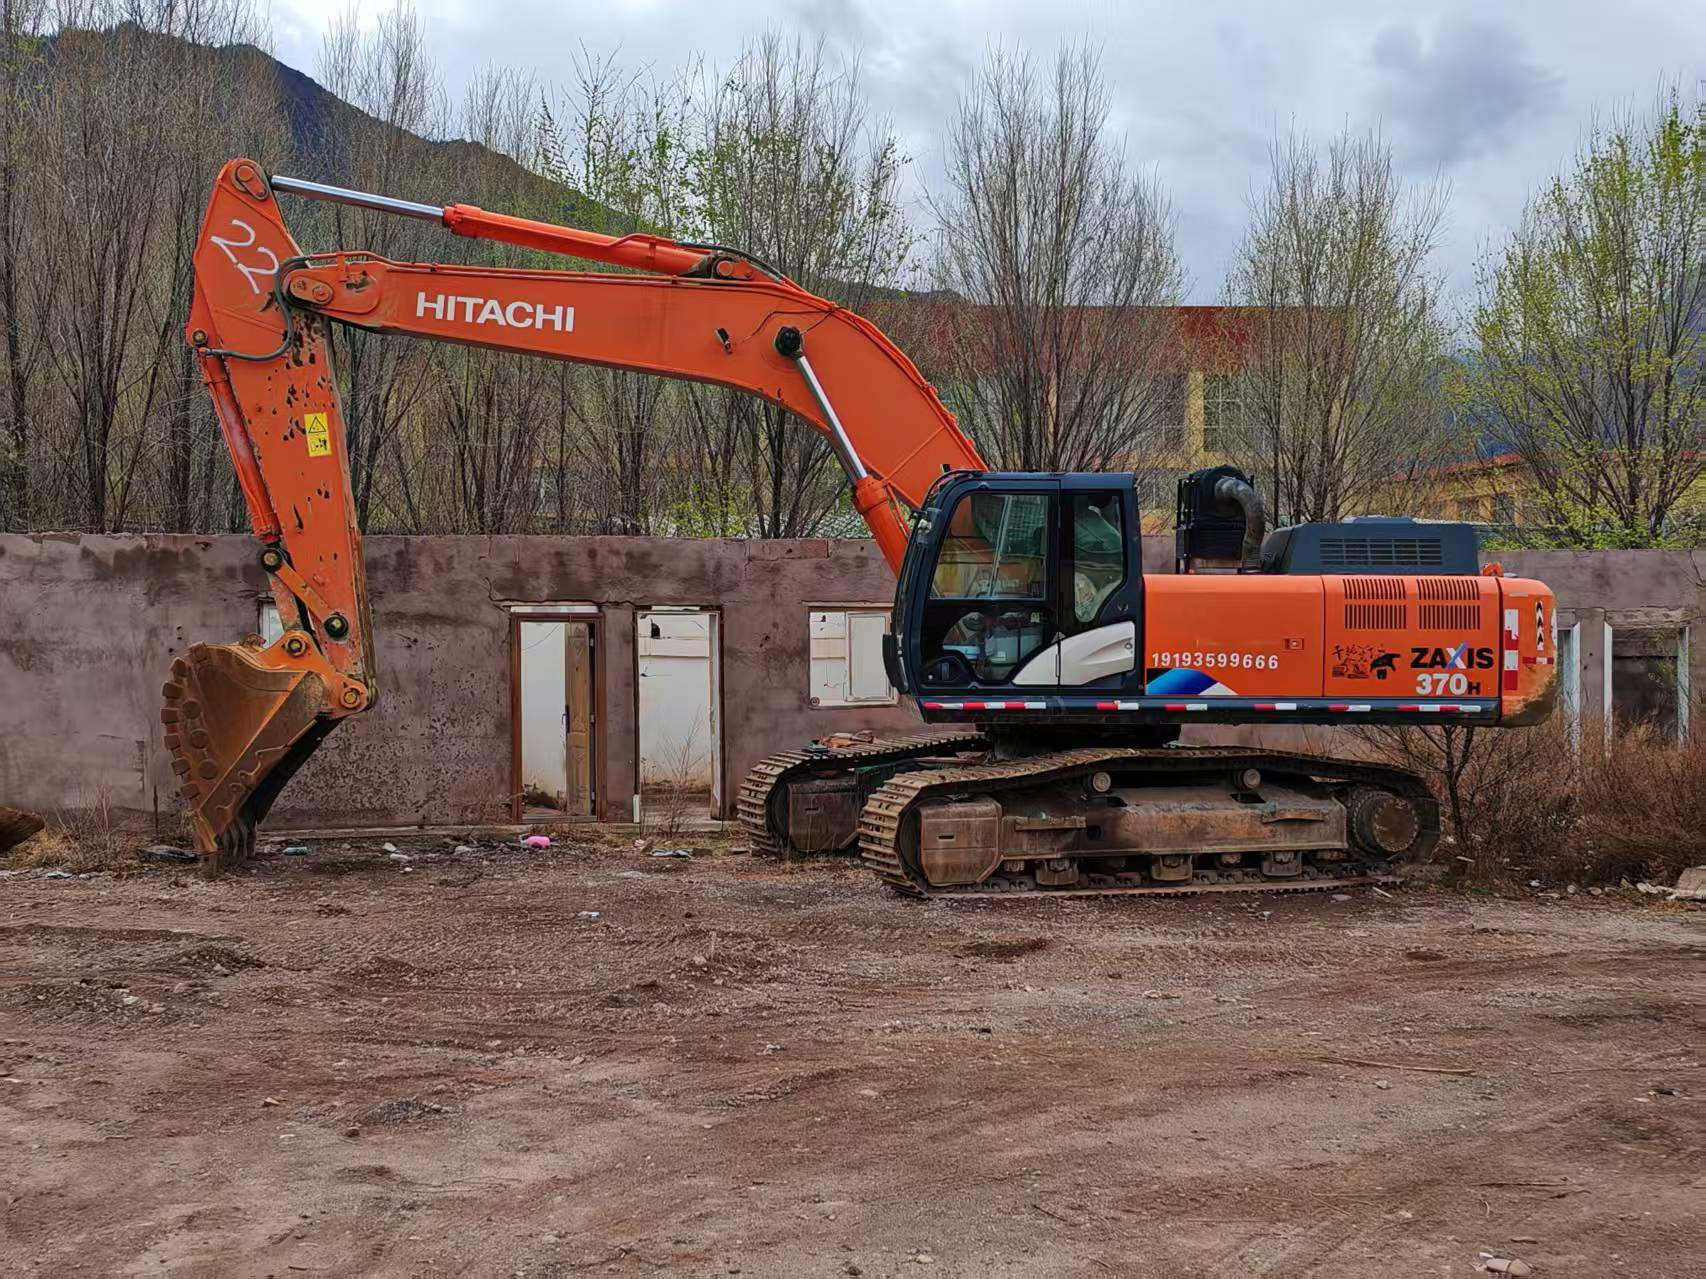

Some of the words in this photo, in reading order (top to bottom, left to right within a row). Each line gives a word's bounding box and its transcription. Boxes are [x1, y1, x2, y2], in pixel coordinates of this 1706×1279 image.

[210, 219, 279, 294] 22
[416, 292, 574, 332] HITACHI
[1152, 652, 1279, 669] 19193599666
[1410, 643, 1494, 669] ZAXIS
